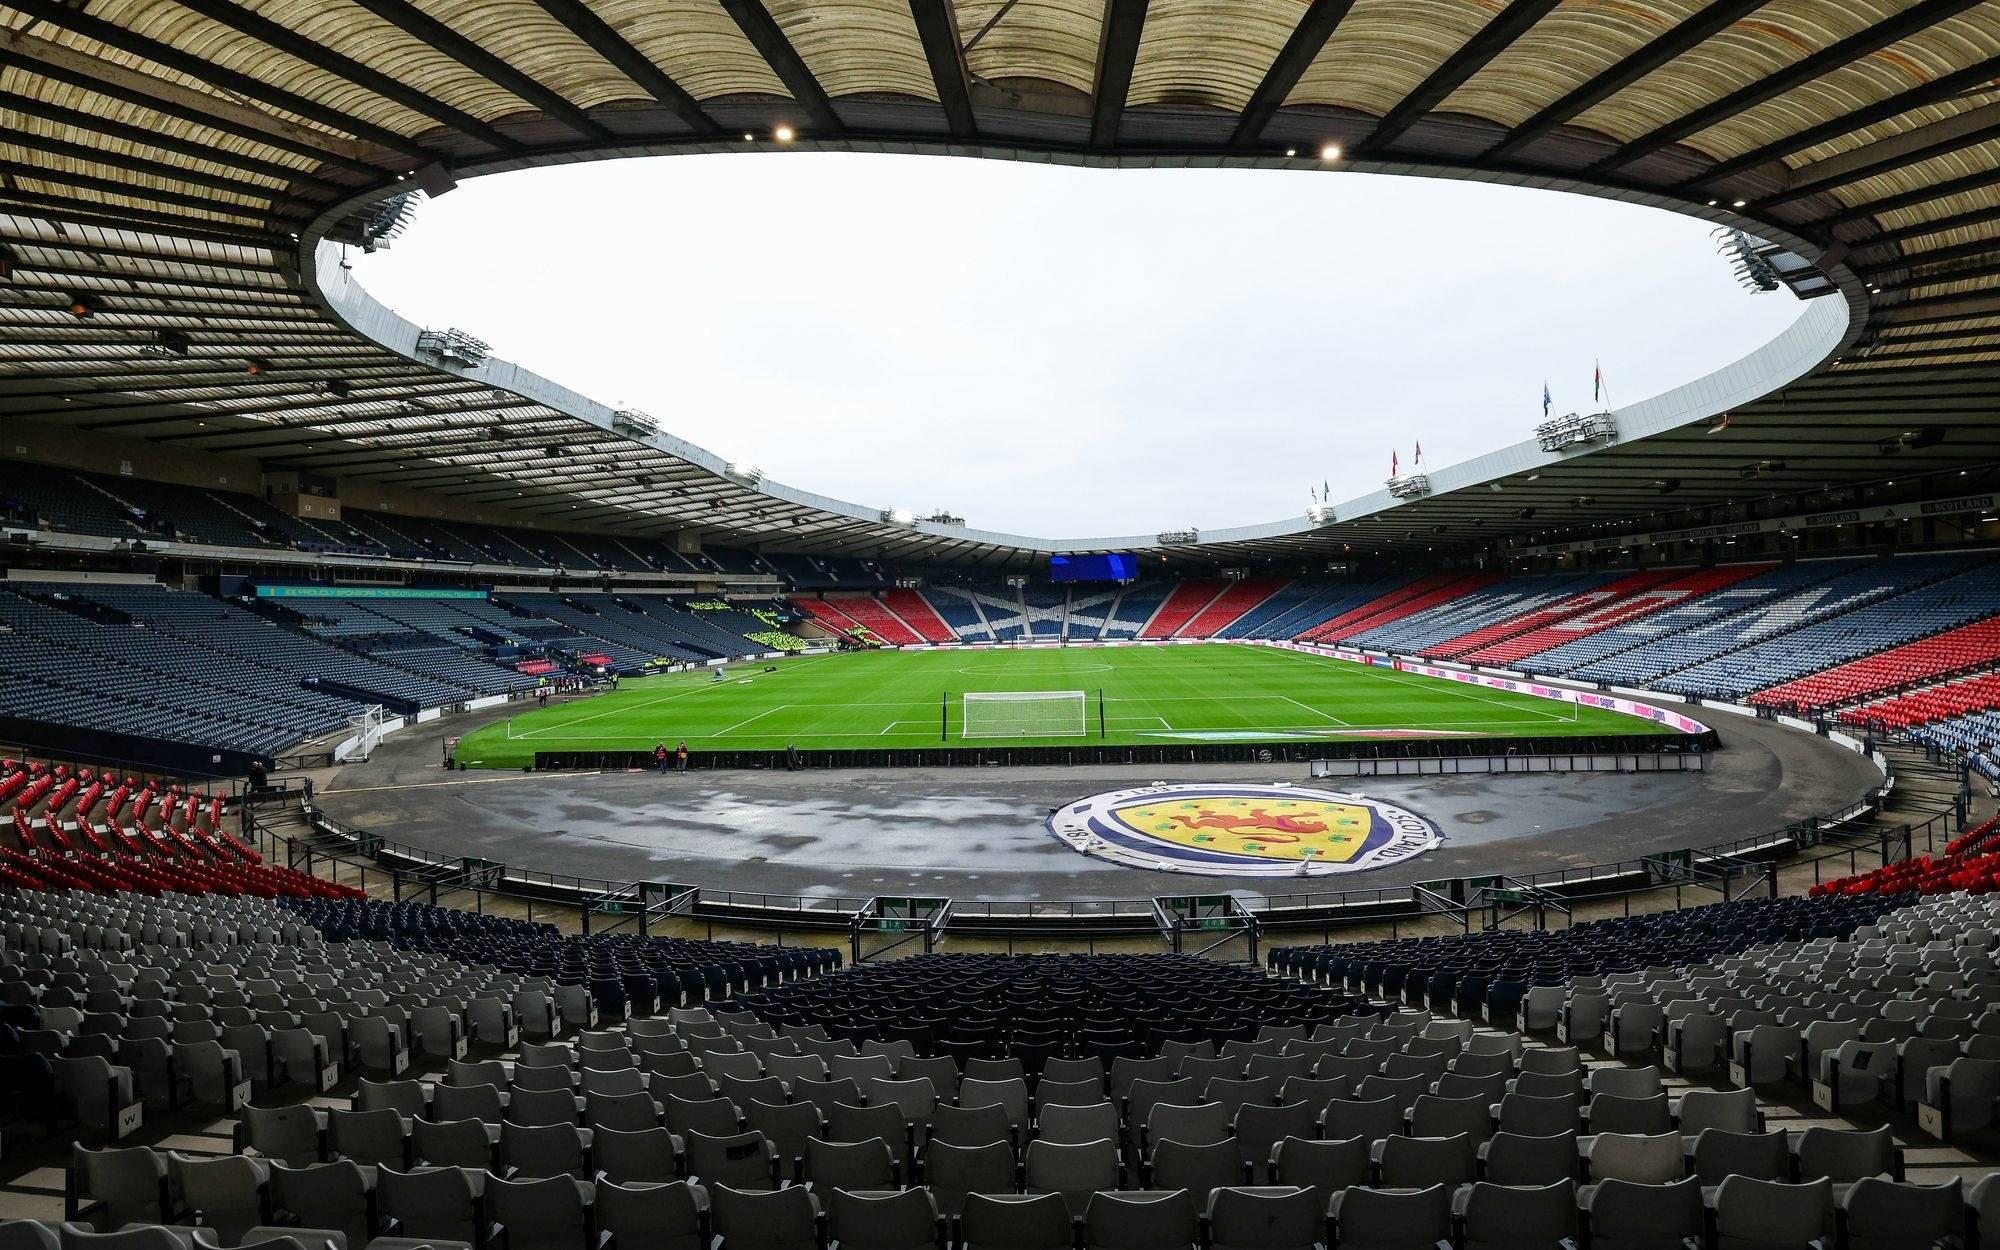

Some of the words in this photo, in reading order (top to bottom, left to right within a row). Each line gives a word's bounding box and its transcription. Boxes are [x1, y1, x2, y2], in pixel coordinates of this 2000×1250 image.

[1935, 496, 1990, 512] SCOTLAND
[1378, 815, 1428, 858] SCOTLAND
[327, 1073, 334, 1082] U
[238, 1091, 245, 1100] V
[124, 1114, 136, 1126] W
[1926, 1114, 1933, 1125] V
